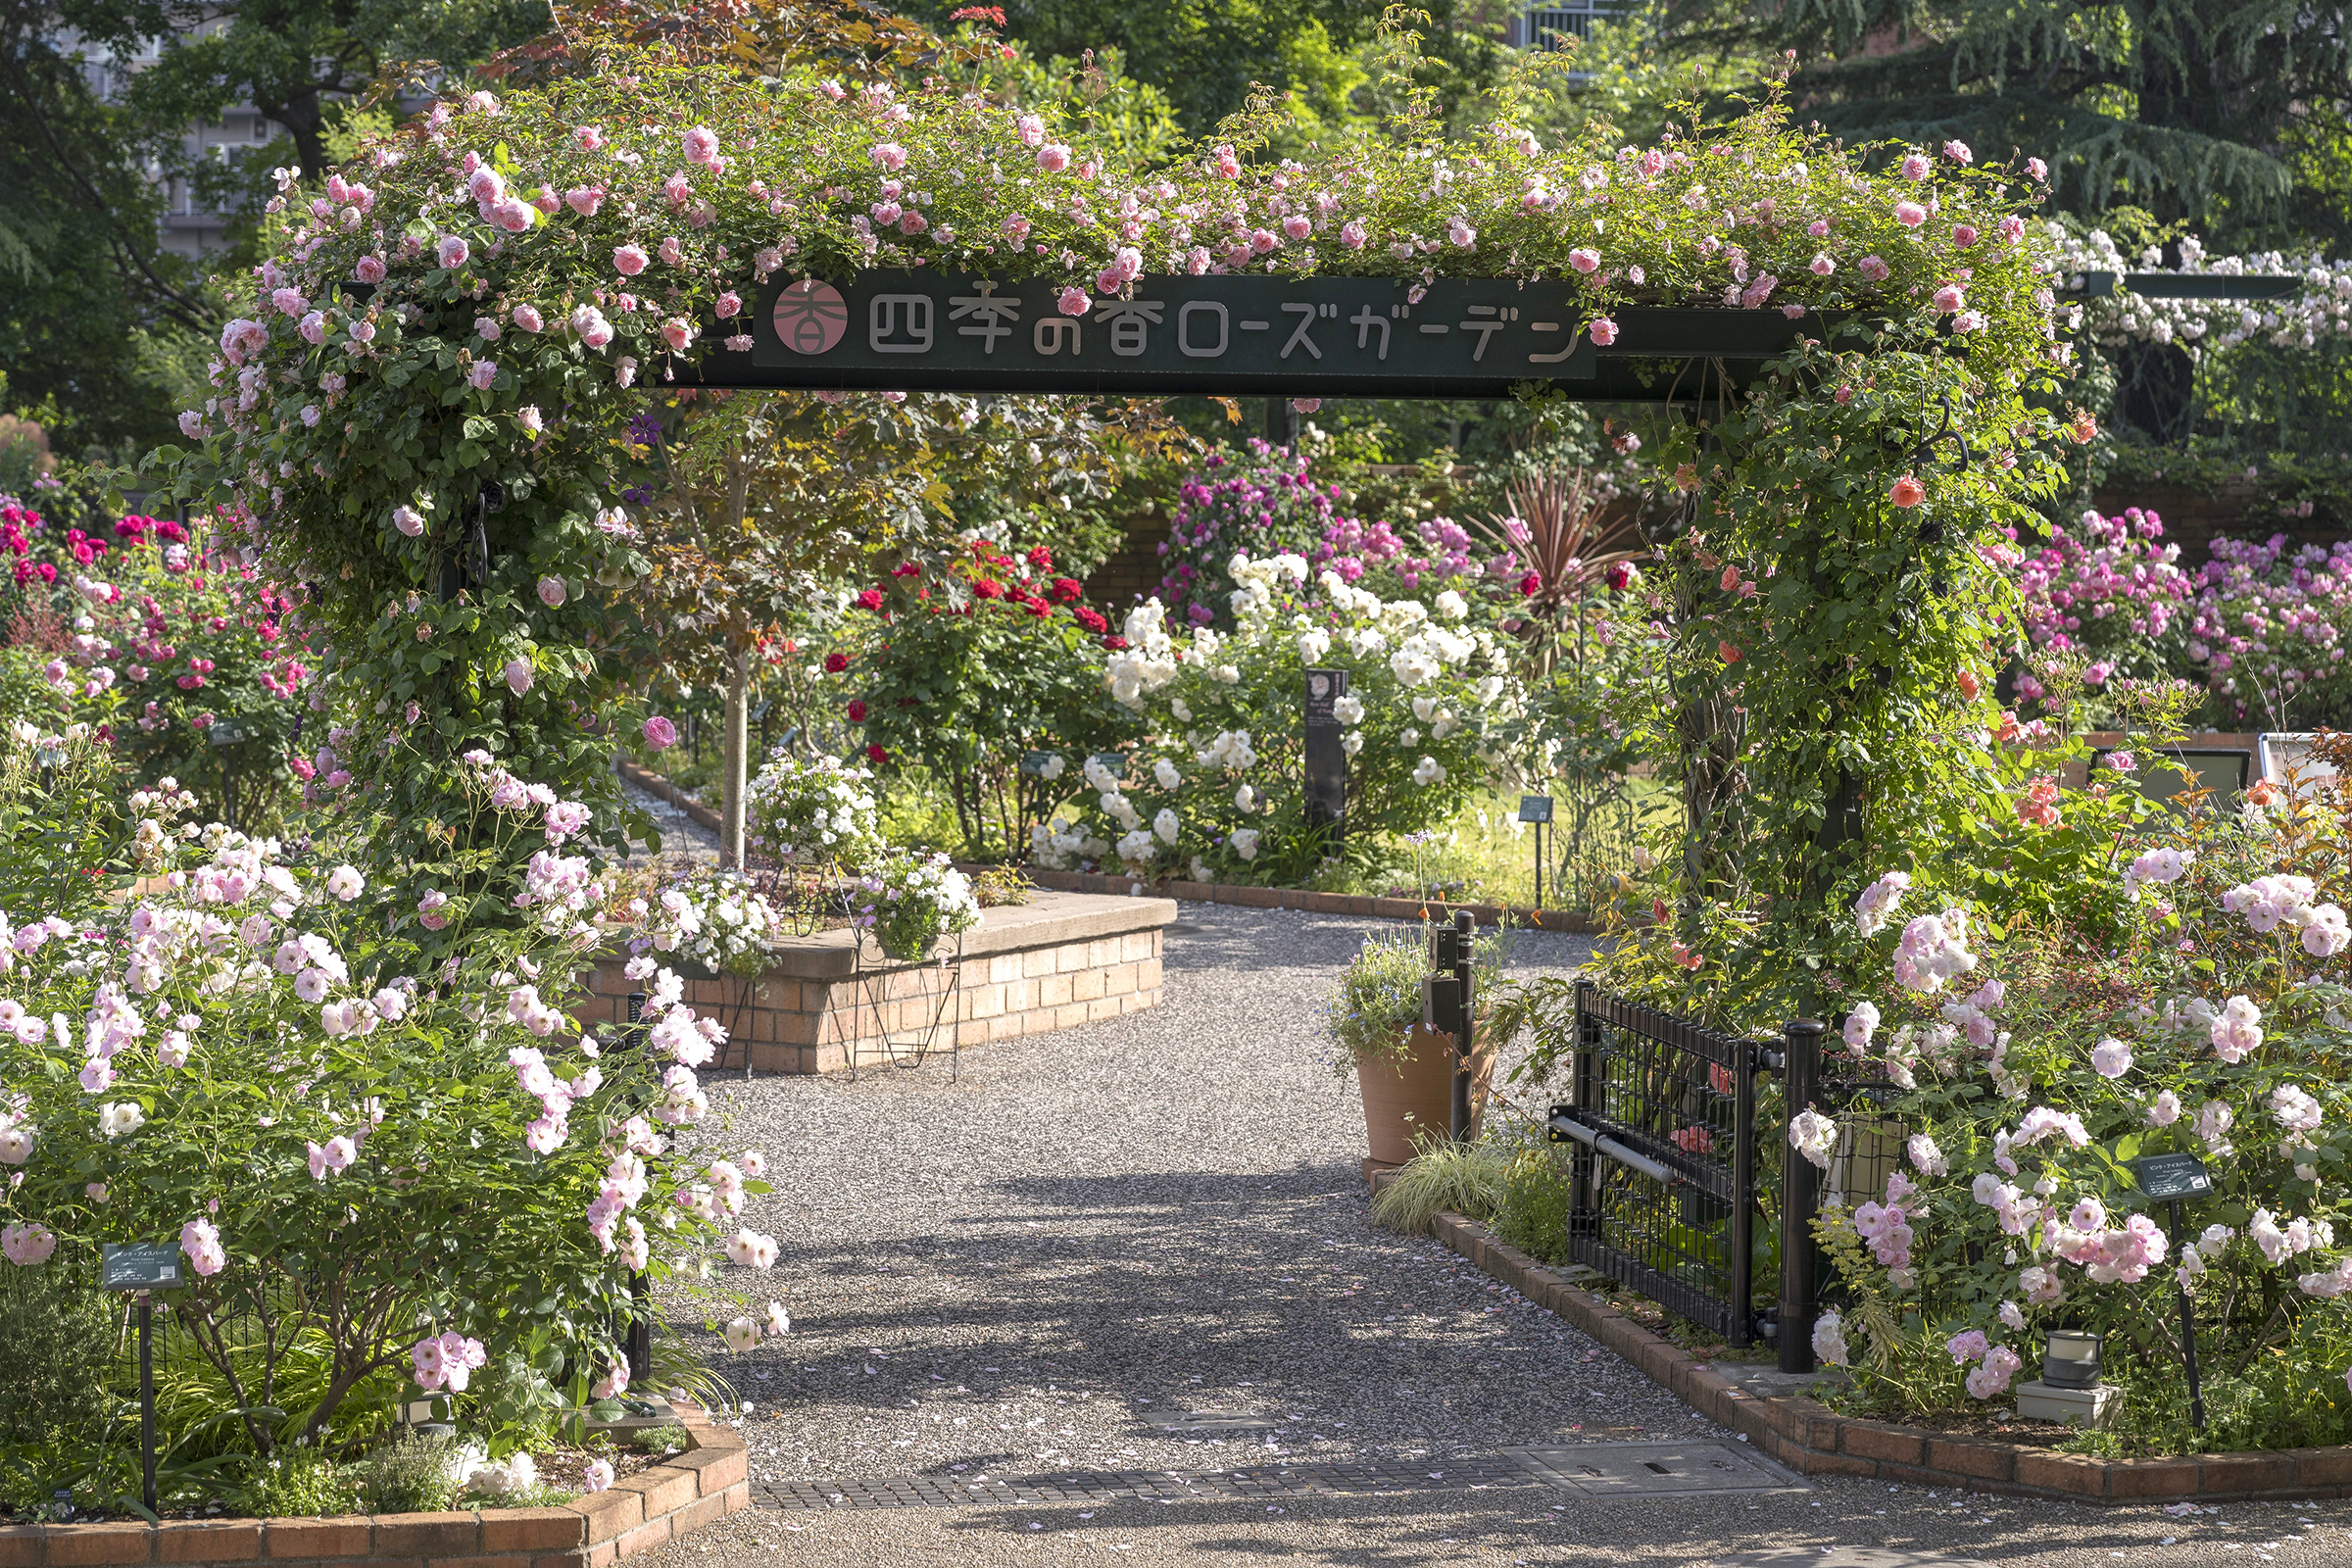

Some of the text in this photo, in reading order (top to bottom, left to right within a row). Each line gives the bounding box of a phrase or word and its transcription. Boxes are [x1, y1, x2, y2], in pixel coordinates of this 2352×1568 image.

[869, 280, 1580, 363] 四季の香ローズガーデン
